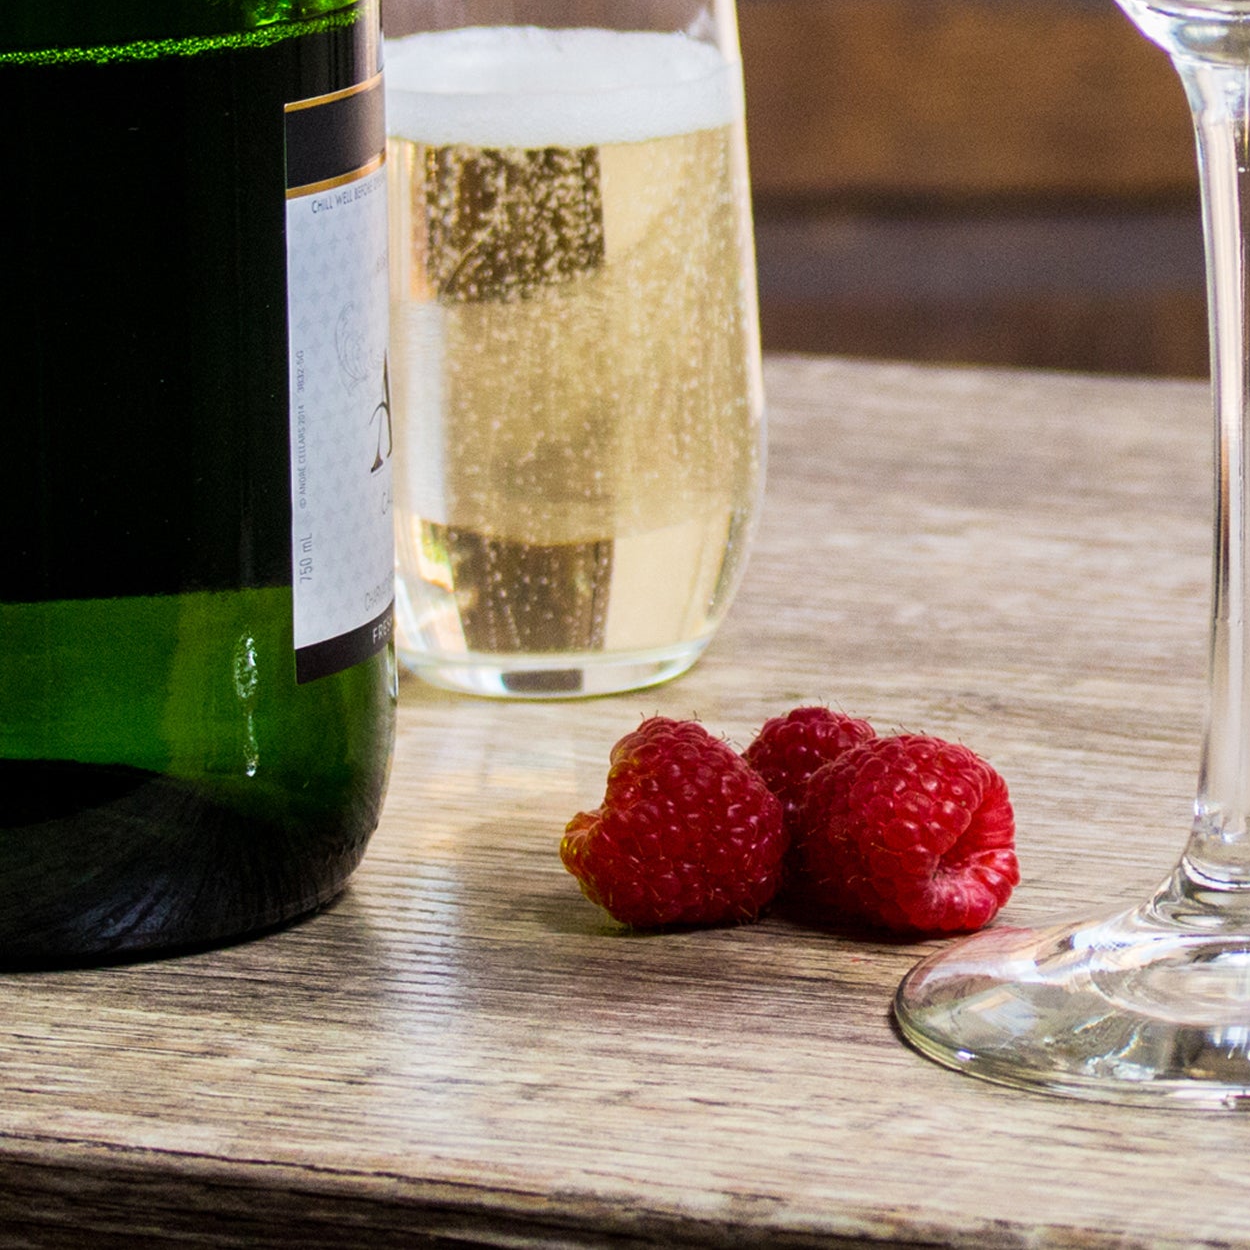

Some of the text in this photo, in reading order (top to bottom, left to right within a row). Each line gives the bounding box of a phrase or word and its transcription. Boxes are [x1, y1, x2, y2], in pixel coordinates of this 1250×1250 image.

[311, 195, 334, 214] CHILL
[334, 189, 354, 207] WELL
[298, 533, 314, 585] 750 mL
